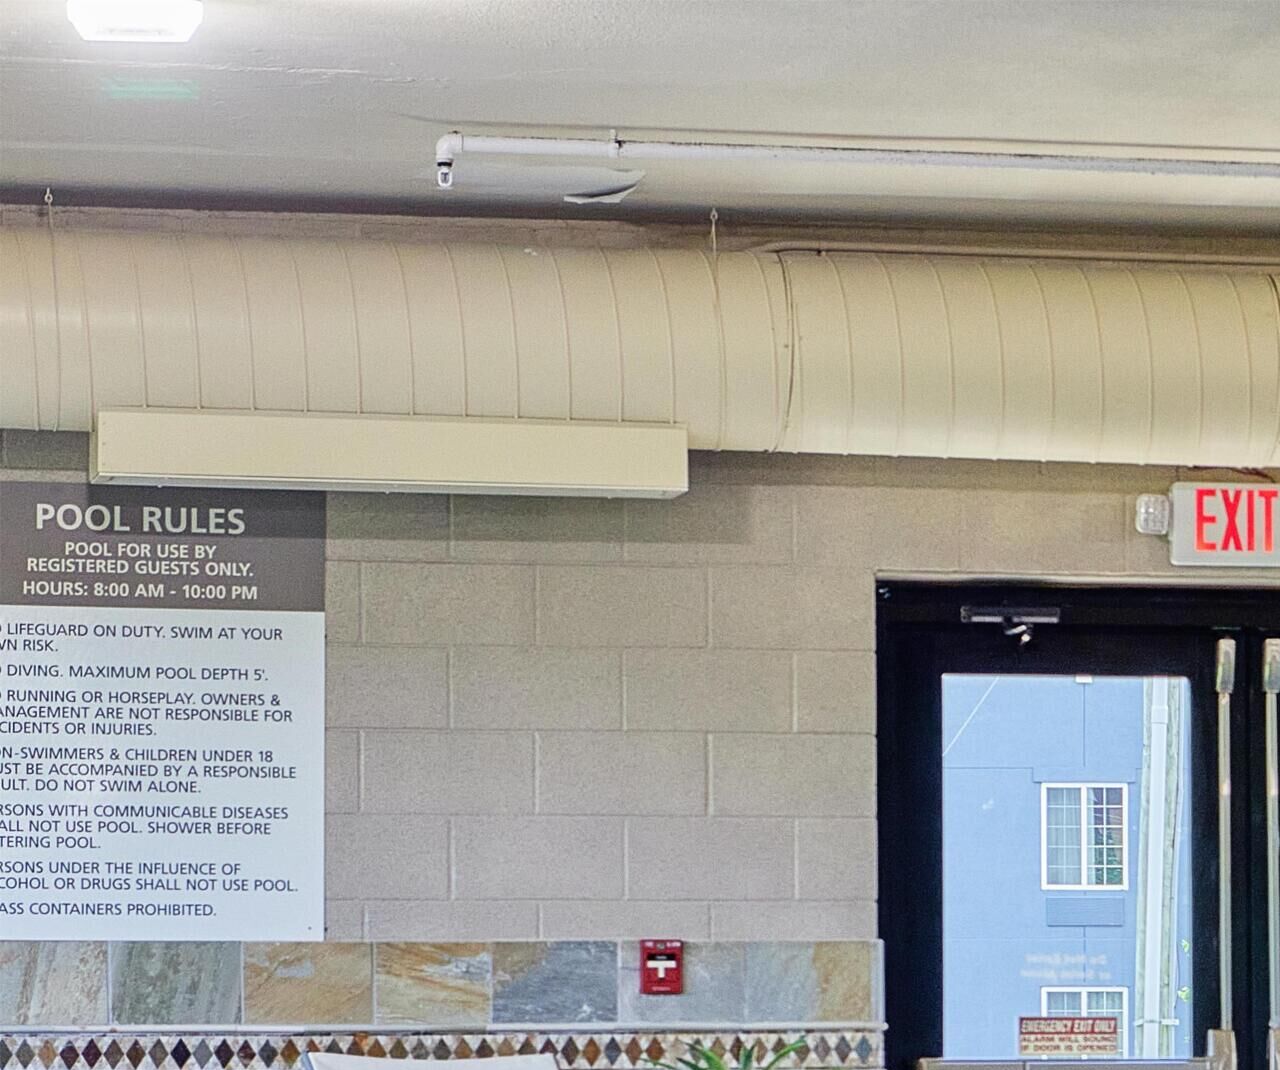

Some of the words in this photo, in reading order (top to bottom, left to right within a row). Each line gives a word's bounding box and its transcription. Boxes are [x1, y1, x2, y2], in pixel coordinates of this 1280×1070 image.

[37, 504, 130, 531] POOL
[143, 507, 245, 534] RULES
[1194, 488, 1279, 552] EXIT
[66, 542, 112, 556] POOL
[118, 543, 150, 557] FOR
[157, 544, 188, 558] USE
[195, 545, 216, 559] BY
[28, 558, 129, 573] REGISTERED
[135, 560, 199, 575] GUESTS
[205, 562, 253, 576] ONLY.
[24, 581, 88, 595] HOURS:
[94, 582, 129, 596] 8:00
[135, 584, 164, 597] AM
[183, 585, 226, 599] 10:00
[232, 586, 257, 599] PM
[8, 623, 88, 636] LIFEGUARD
[94, 625, 116, 637] ON
[122, 626, 165, 638] DUTY.
[171, 627, 212, 638] SWIM
[218, 628, 236, 639] AT
[241, 628, 282, 640] YOUR
[23, 639, 58, 651] RISK.
[8, 664, 63, 677] DIVING.
[70, 666, 150, 678] MAXIMUM
[156, 667, 196, 679] POOL
[202, 668, 248, 680] DEPTH
[8, 690, 76, 702] RUNNING
[82, 691, 103, 703] OR
[109, 692, 195, 704] HORSEPLAY.
[201, 693, 265, 706] OWNERS
[271, 695, 280, 706] &
[95, 707, 123, 719] ARE
[129, 708, 160, 719] NOT
[166, 708, 258, 721] RESPONSIBLE
[264, 710, 292, 722] FOR
[65, 723, 85, 734] OR
[92, 723, 156, 735] INJURIES.
[0, 747, 104, 760] N-SWIMMERS
[110, 748, 119, 760] &
[125, 749, 197, 761] CHILDREN
[203, 750, 253, 762] UNDER
[259, 751, 273, 762] 18
[26, 763, 43, 775] BE
[48, 764, 158, 776] ACCOMPANIED
[164, 765, 182, 776] BY
[188, 766, 198, 776] A
[204, 766, 296, 778] RESPONSIBLE
[36, 779, 58, 791] DO
[64, 780, 95, 791] NOT
[100, 780, 142, 792] SWIM
[148, 781, 201, 793] ALONE.
[49, 805, 87, 816] WITH
[94, 805, 216, 818] COMMUNICABLE
[223, 807, 288, 819] DISEASES
[29, 820, 60, 832] NOT
[66, 821, 92, 832] USE
[98, 821, 142, 833] POOL.
[148, 822, 211, 834] SHOWER
[217, 823, 270, 835] BEFORE
[57, 837, 100, 848] POOL.
[49, 862, 100, 873] UNDER
[105, 862, 132, 874] THE
[139, 863, 216, 875] INFLUENCE
[222, 863, 240, 875] OF
[54, 878, 75, 889] OR
[81, 878, 130, 890] DRUGS
[136, 878, 181, 890] SHALL
[186, 879, 217, 891] NOT
[223, 879, 248, 891] USE
[254, 880, 298, 891] POOL.
[30, 903, 122, 915] CONTAINERS
[128, 904, 216, 916] PROHIBITED.
